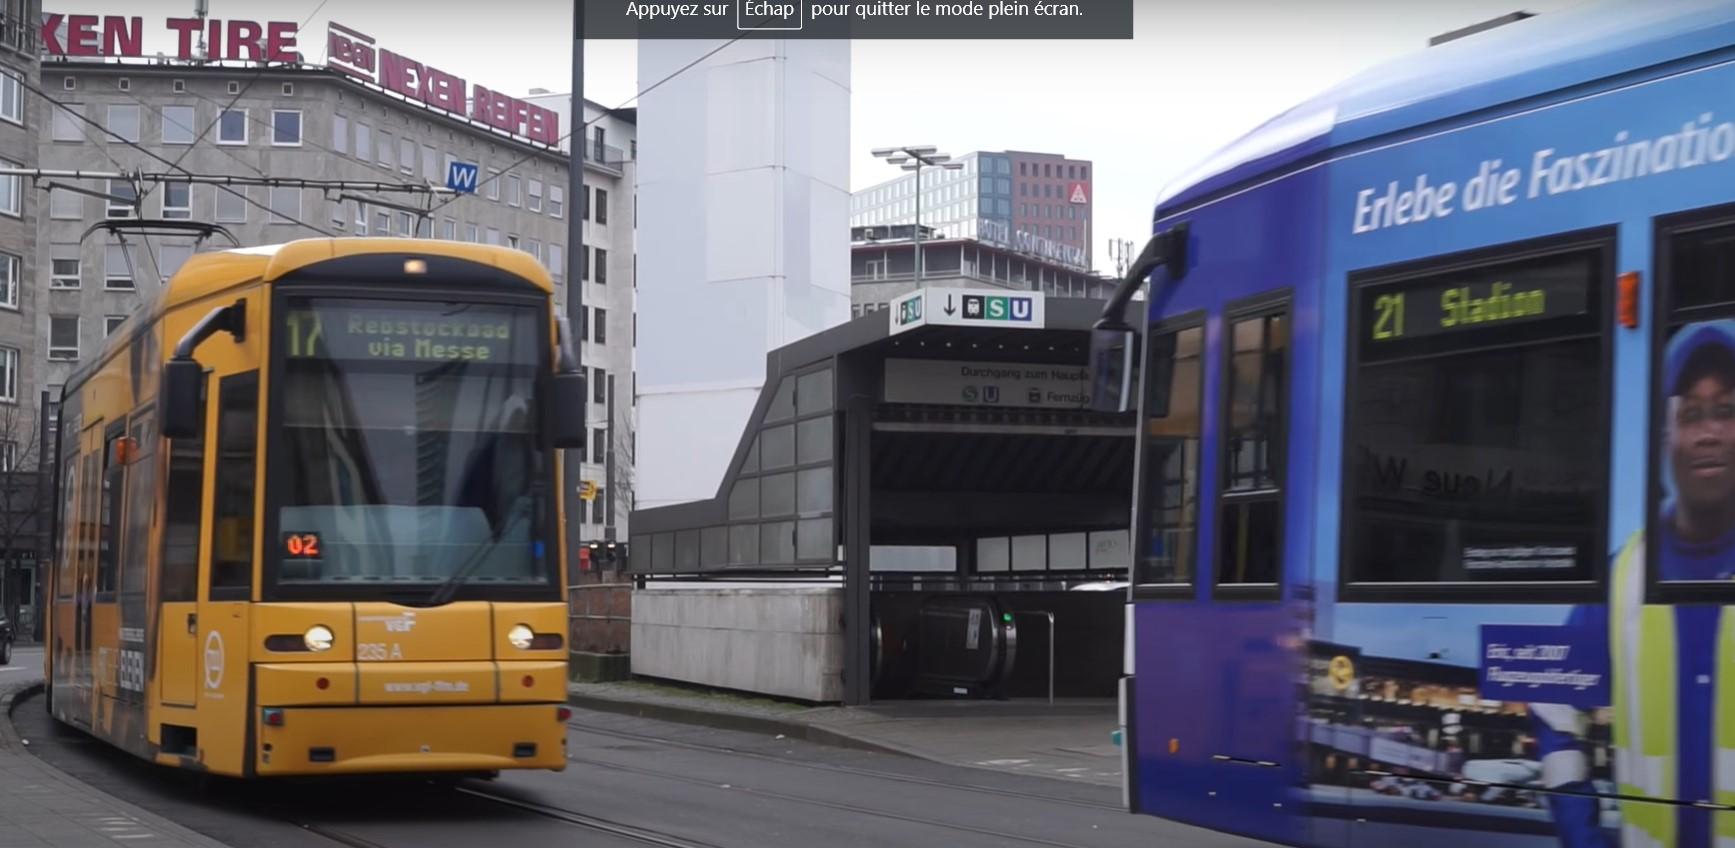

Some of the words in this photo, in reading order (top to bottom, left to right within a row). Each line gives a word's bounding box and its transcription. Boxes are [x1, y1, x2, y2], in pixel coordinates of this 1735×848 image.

[166, 17, 298, 63] TIRE
[379, 47, 467, 116] NEXEN
[472, 83, 560, 148] REIFEN
[453, 165, 476, 188] W
[1352, 173, 1458, 235] Erlebe
[1462, 157, 1522, 212] die
[989, 299, 1004, 317] S
[1012, 300, 1029, 318] U
[1373, 292, 1405, 340] 21
[1440, 281, 1546, 328] Stadion
[287, 310, 323, 357] 17
[368, 338, 405, 358] via
[414, 339, 490, 361] Messe
[960, 366, 1021, 380] Durchgang
[1024, 370, 1048, 380] zum
[287, 534, 319, 555] 02
[357, 642, 388, 660] 235
[390, 642, 403, 660] A
